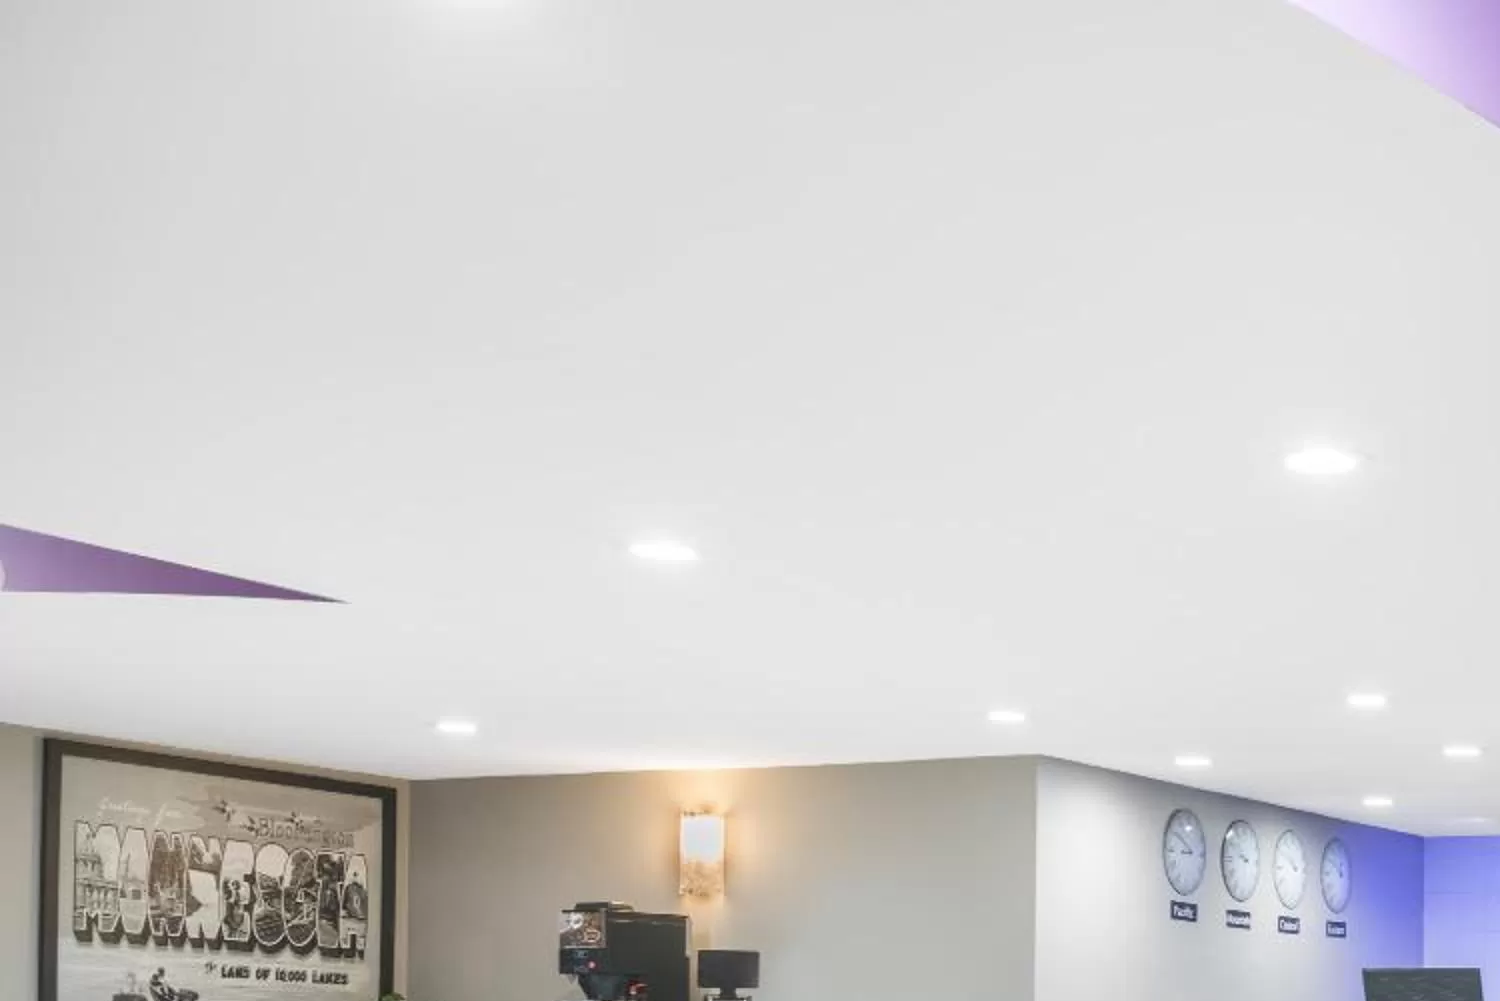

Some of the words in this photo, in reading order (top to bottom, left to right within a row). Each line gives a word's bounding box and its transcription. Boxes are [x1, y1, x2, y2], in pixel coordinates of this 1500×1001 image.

[73, 820, 369, 958] MINNESOTA
[255, 966, 271, 981] OF
[311, 969, 349, 986] LAKES
